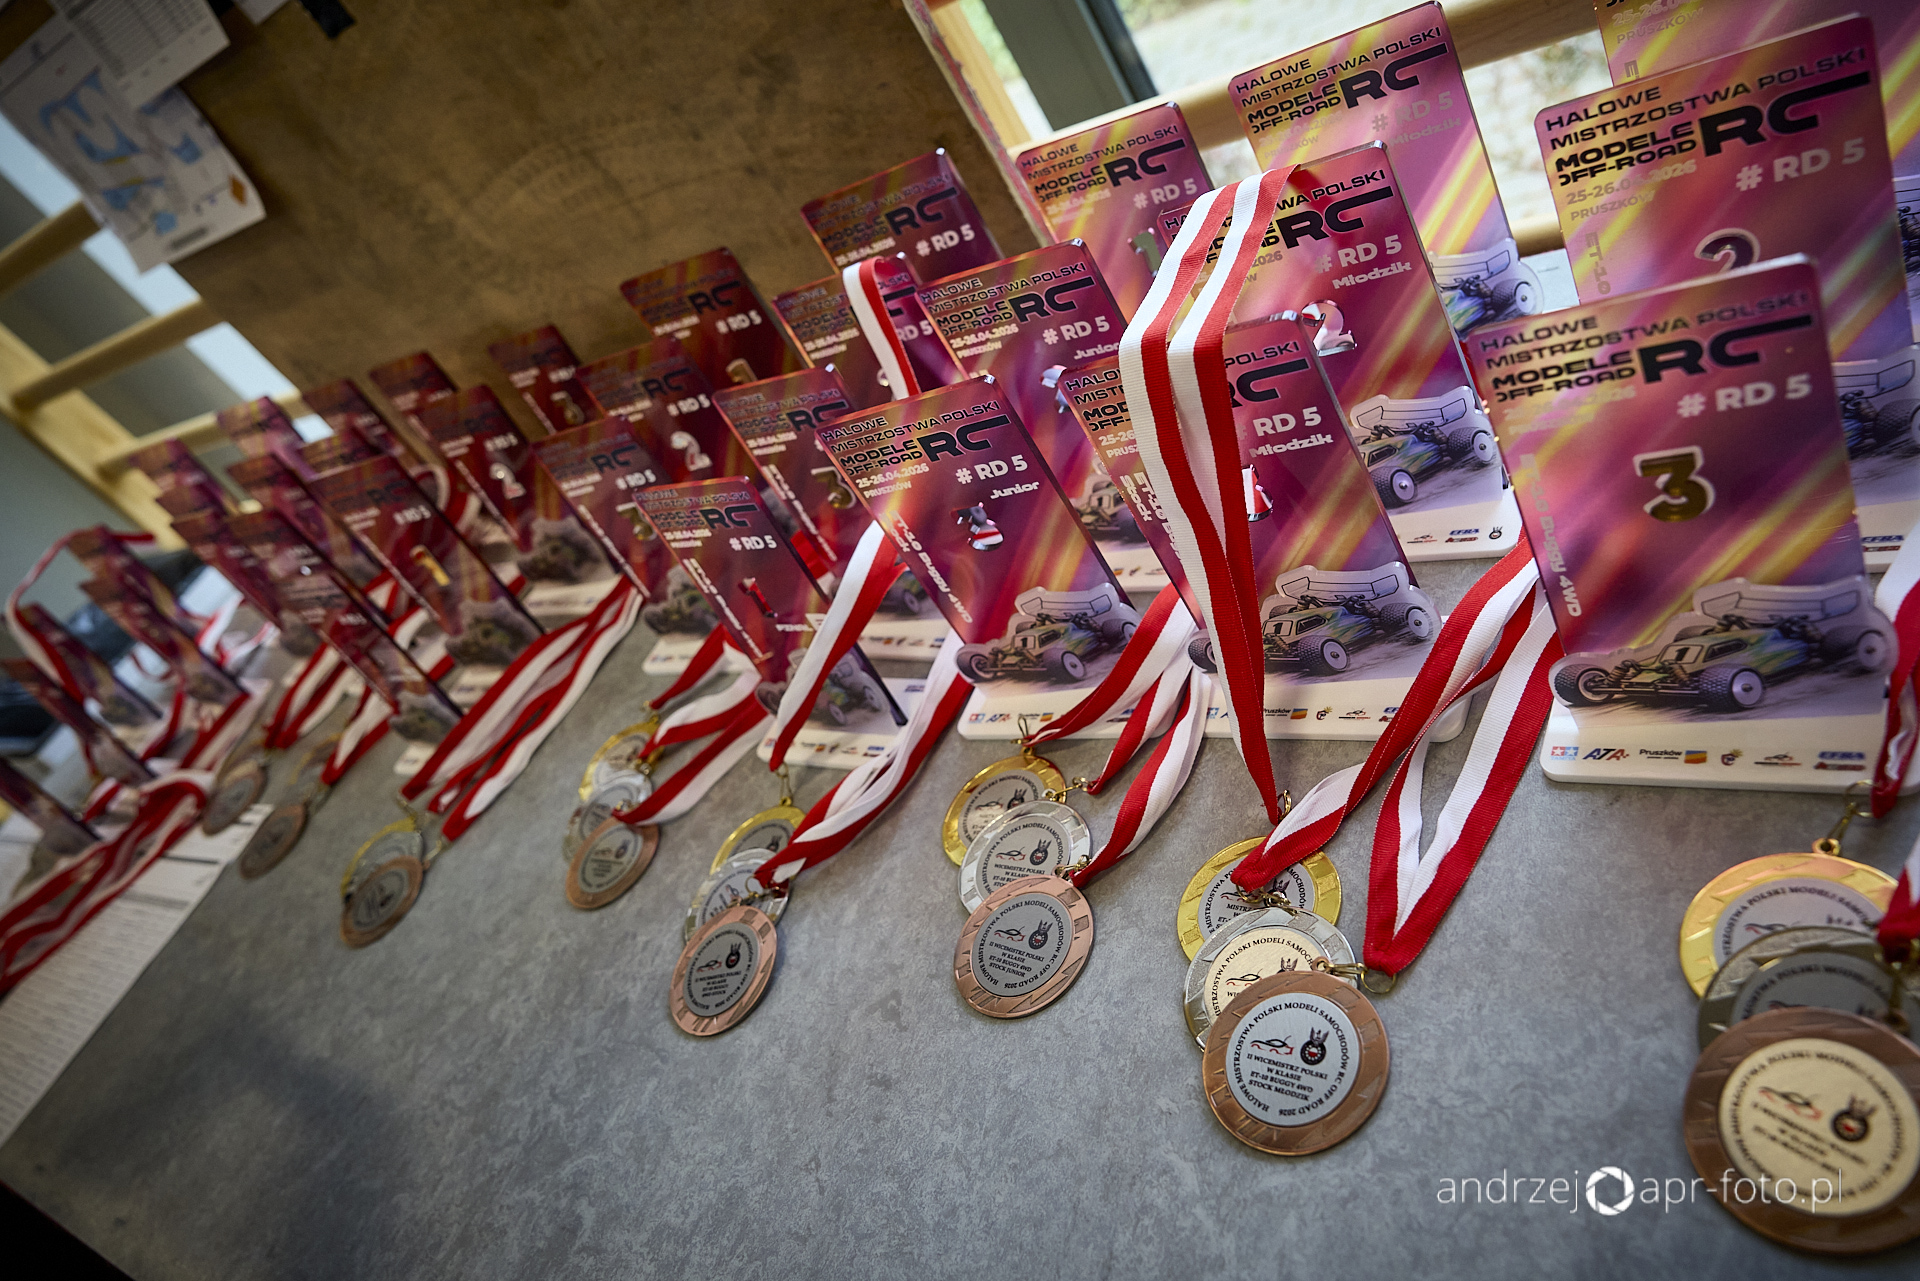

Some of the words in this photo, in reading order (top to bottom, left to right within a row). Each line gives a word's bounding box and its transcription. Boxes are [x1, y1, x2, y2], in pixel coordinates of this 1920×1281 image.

[1617, 7, 1704, 44] PRUSZKÓW
[1236, 59, 1311, 94] HALOWE
[1241, 55, 1371, 108] MISTRZOSTWA
[1373, 27, 1441, 59] POLSKI
[1339, 43, 1448, 109] RC
[1247, 83, 1338, 124] MODELE
[1395, 100, 1431, 124] RD
[1438, 91, 1453, 111] 5
[1546, 87, 1661, 131] HALOWE
[1551, 83, 1751, 150] MISTRZOSTWA
[1757, 48, 1865, 90] POLSKI
[1698, 70, 1871, 157] RC
[1021, 143, 1079, 169] HALOWE
[1027, 142, 1126, 181] MISTRZOSTWA
[1127, 125, 1179, 149] POLSKI
[1555, 121, 1694, 172] MODELE
[1104, 138, 1186, 187] RC
[1736, 164, 1763, 191] #
[1773, 148, 1831, 182] RD
[1842, 138, 1865, 164] 5
[1035, 166, 1104, 194] MODELE
[1150, 184, 1180, 205] RD
[1183, 178, 1198, 196] 5
[1311, 169, 1386, 200] POLSKI
[885, 187, 957, 235] RC
[1276, 186, 1394, 249] RC
[931, 230, 960, 251] RD
[960, 223, 975, 241] 5
[1314, 254, 1333, 274] #
[1337, 242, 1378, 268] RD
[1384, 234, 1402, 255] 5
[929, 280, 1031, 313] MISTRZOSTWA
[1032, 262, 1086, 284] POLSKI
[1331, 261, 1412, 290] Młodzik
[688, 279, 741, 315] RC
[921, 279, 982, 302] HALOWE
[1008, 276, 1095, 323] RC
[919, 319, 934, 336] 5
[937, 301, 1008, 326] MODELE
[1042, 328, 1059, 345] #
[1060, 321, 1092, 340] RD
[1095, 316, 1110, 332] 5
[1480, 316, 1598, 352] HALOWE
[1486, 317, 1689, 369] MISTRZOSTWA
[1074, 342, 1120, 360] Junior
[1224, 341, 1300, 368] POLSKI
[1638, 314, 1812, 384] RC
[642, 367, 691, 398] RC
[1066, 368, 1121, 391] HALO
[1492, 351, 1633, 389] MODELE
[1677, 393, 1706, 418] #
[1716, 382, 1775, 412] RD
[1785, 373, 1812, 399] 5
[786, 399, 849, 431] RC
[822, 417, 888, 441] HALOWE
[831, 418, 942, 453] MISTRZOSTWA
[941, 401, 1000, 423] POLSKI
[1253, 413, 1296, 437] RD
[1303, 406, 1322, 427] 5
[840, 439, 918, 467] MODELE
[917, 415, 1011, 462] RC
[1248, 433, 1334, 458] Młodzik
[591, 444, 638, 473] RC
[956, 467, 973, 485] #
[974, 460, 1009, 481] RD
[1011, 454, 1028, 472] 5
[811, 466, 857, 509] 3
[856, 463, 930, 489] 25-26.04.2026
[864, 481, 912, 499] PRUSZKÓW
[990, 481, 1040, 500] Junior
[1632, 445, 1715, 522] 3
[699, 503, 760, 529] RC
[740, 536, 765, 550] RD
[764, 535, 777, 549] 5
[1559, 575, 1582, 617] 4WD
[1640, 749, 1682, 758] Pruszków
[1000, 826, 1021, 840] POLSKI
[1000, 901, 1023, 916] POLSKI
[1024, 900, 1049, 909] MODELI
[1205, 879, 1225, 928] MISTRZOSTWA
[978, 917, 1000, 963] MISTRZOSTWA
[1048, 906, 1064, 953] SAMOCHODÓW
[994, 943, 1025, 956] WICEMISTRZ
[1026, 952, 1045, 962] POLSKI
[1002, 958, 1019, 968] BUGGY
[1007, 954, 1025, 963] KLASIE
[1049, 954, 1058, 964] RC
[1226, 942, 1251, 963] POLSKI
[1253, 937, 1285, 945] MODELI
[980, 963, 999, 985] HALOWE
[989, 962, 1006, 971] STOCK
[1006, 968, 1025, 977] JUNIOR
[1019, 974, 1039, 987] ROAD
[1040, 964, 1050, 976] OFF
[1254, 1004, 1282, 1023] POLSKI
[1284, 1002, 1318, 1013] MODELI
[1234, 1023, 1254, 1084] MISTRZOSTWA
[1318, 1010, 1349, 1070] SAMOCHODÓW
[1250, 1071, 1268, 1080] ET-10
[1270, 1074, 1295, 1087] BUGGY
[1296, 1083, 1313, 1092] 4WD
[1254, 1055, 1299, 1072] WICEMISTRZ
[1301, 1068, 1328, 1079] POLSKI
[1274, 1069, 1302, 1081] KLASIE
[1335, 1071, 1345, 1084] RC
[1240, 1084, 1270, 1112] HALOWE
[1248, 1080, 1272, 1091] STOCK
[1274, 1086, 1309, 1100] MŁODZIK
[1324, 1084, 1338, 1098] OFF
[1299, 1097, 1324, 1114] ROAD
